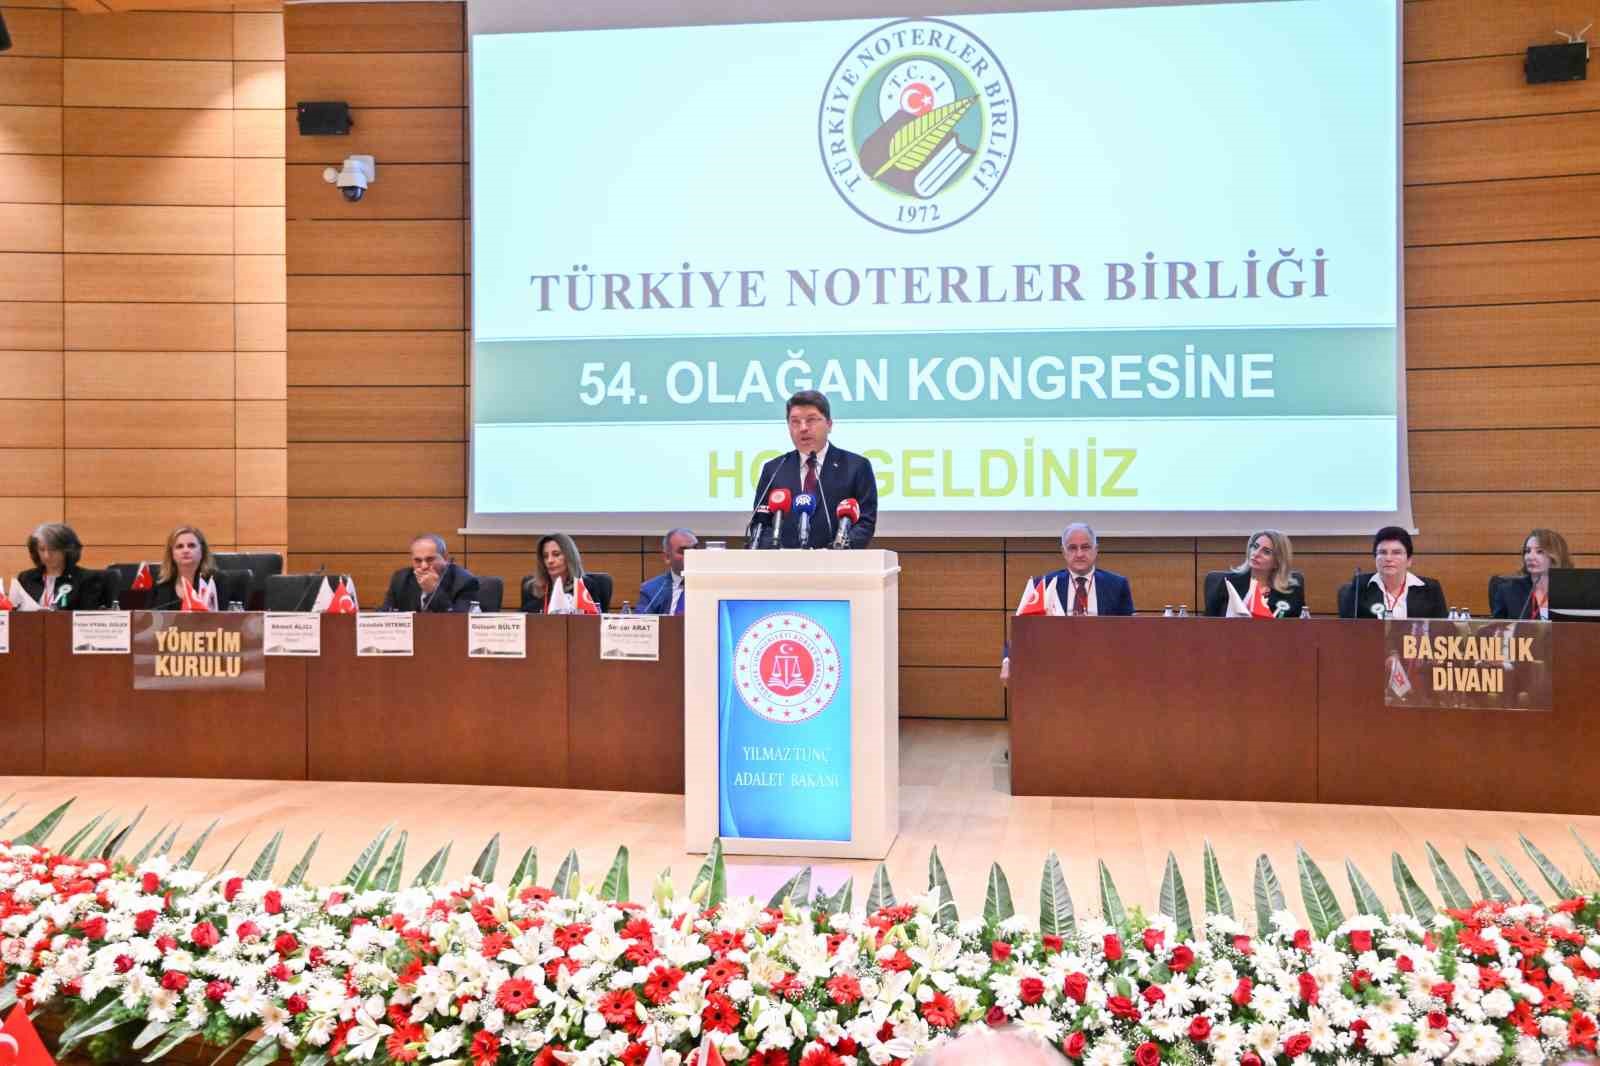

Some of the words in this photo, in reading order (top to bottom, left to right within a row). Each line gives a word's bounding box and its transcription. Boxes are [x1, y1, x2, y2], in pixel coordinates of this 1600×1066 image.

[826, 68, 862, 193] TÜRKİYE
[857, 28, 989, 78] NOTERLER
[972, 79, 1010, 191] BİRLİĞİ
[896, 203, 941, 223] 1972
[530, 262, 767, 312] TÜRKİYE
[786, 264, 1086, 306] NOTERLER
[1104, 247, 1329, 301] BİRLİĞİ
[579, 360, 648, 406] 54.
[666, 349, 889, 404] OLAĞAN
[908, 344, 1275, 401] KONGRESİNE
[155, 626, 241, 653] YÖNETİM
[1402, 635, 1535, 665] BAŞKANLIK
[154, 655, 241, 678] KURULU
[1432, 662, 1504, 692] DİVANI
[743, 745, 792, 761] YILMAZ
[734, 771, 784, 787] ADALET
[791, 773, 840, 788] BAKANI
